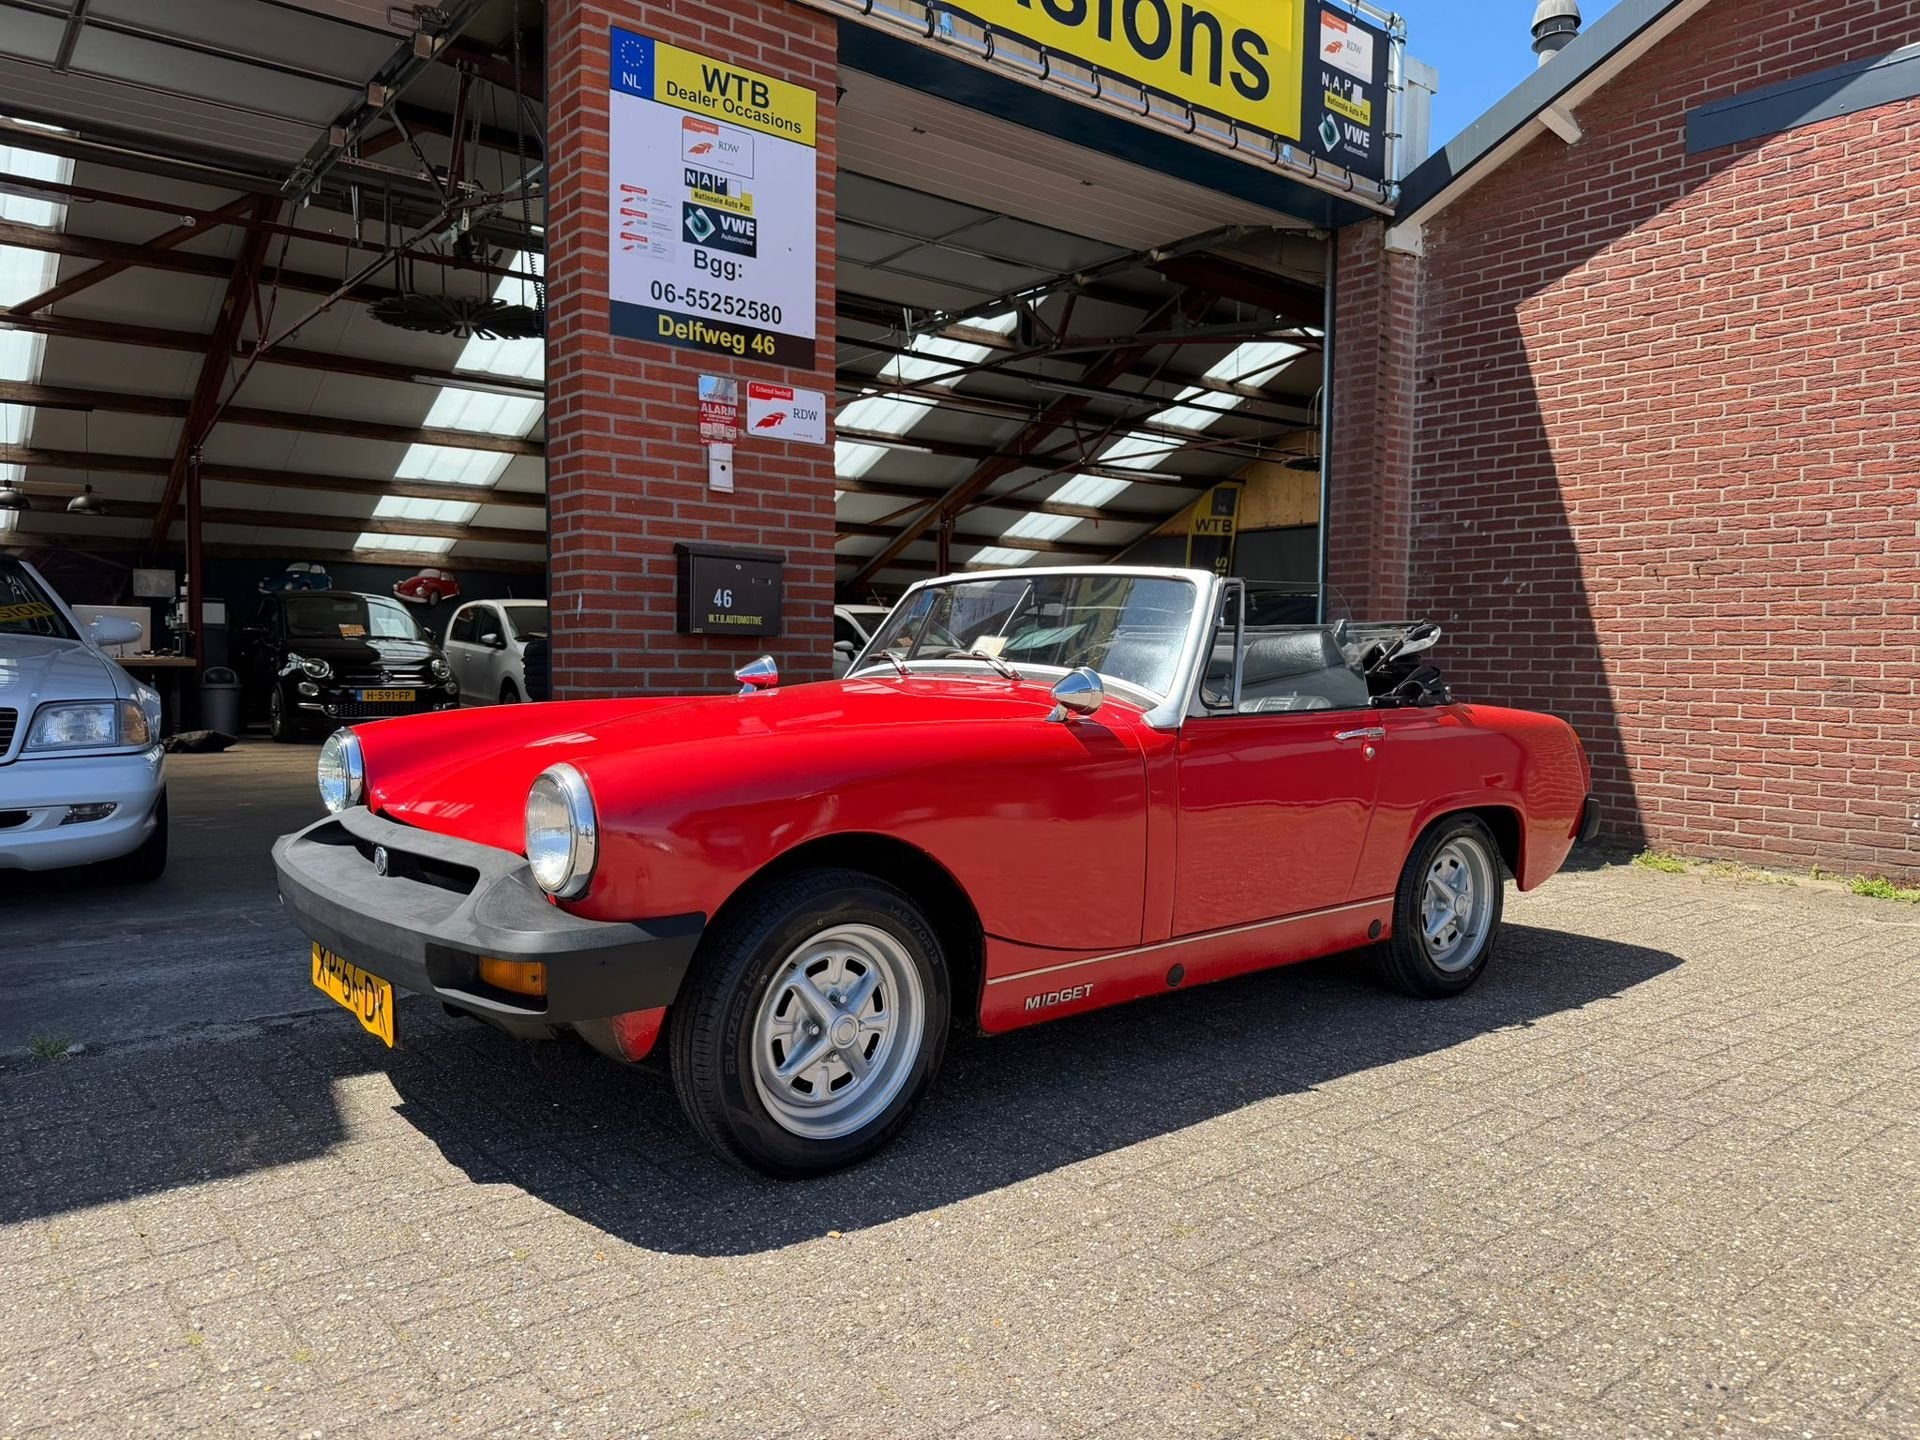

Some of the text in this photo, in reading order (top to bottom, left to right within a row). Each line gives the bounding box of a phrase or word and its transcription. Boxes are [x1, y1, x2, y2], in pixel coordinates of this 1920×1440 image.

[622, 71, 642, 90] NL
[702, 64, 770, 109] WTB
[667, 80, 718, 108] Dealer
[723, 99, 802, 134] Occasions
[1344, 122, 1370, 148] VWE
[718, 140, 739, 153] RDW
[694, 191, 751, 212] Nationale Auto Pas
[720, 215, 755, 236] VWE
[721, 232, 754, 246] Automotive
[694, 249, 743, 281] Bgg:
[651, 280, 782, 325] 06-55252580
[658, 314, 776, 355] Delfweg 46
[701, 403, 736, 417] ALARM
[793, 408, 818, 421] RDW
[1196, 518, 1233, 532] WTB
[713, 588, 732, 608] 46
[367, 691, 411, 699] H-591-FP
[1025, 984, 1094, 1011] MIDGET
